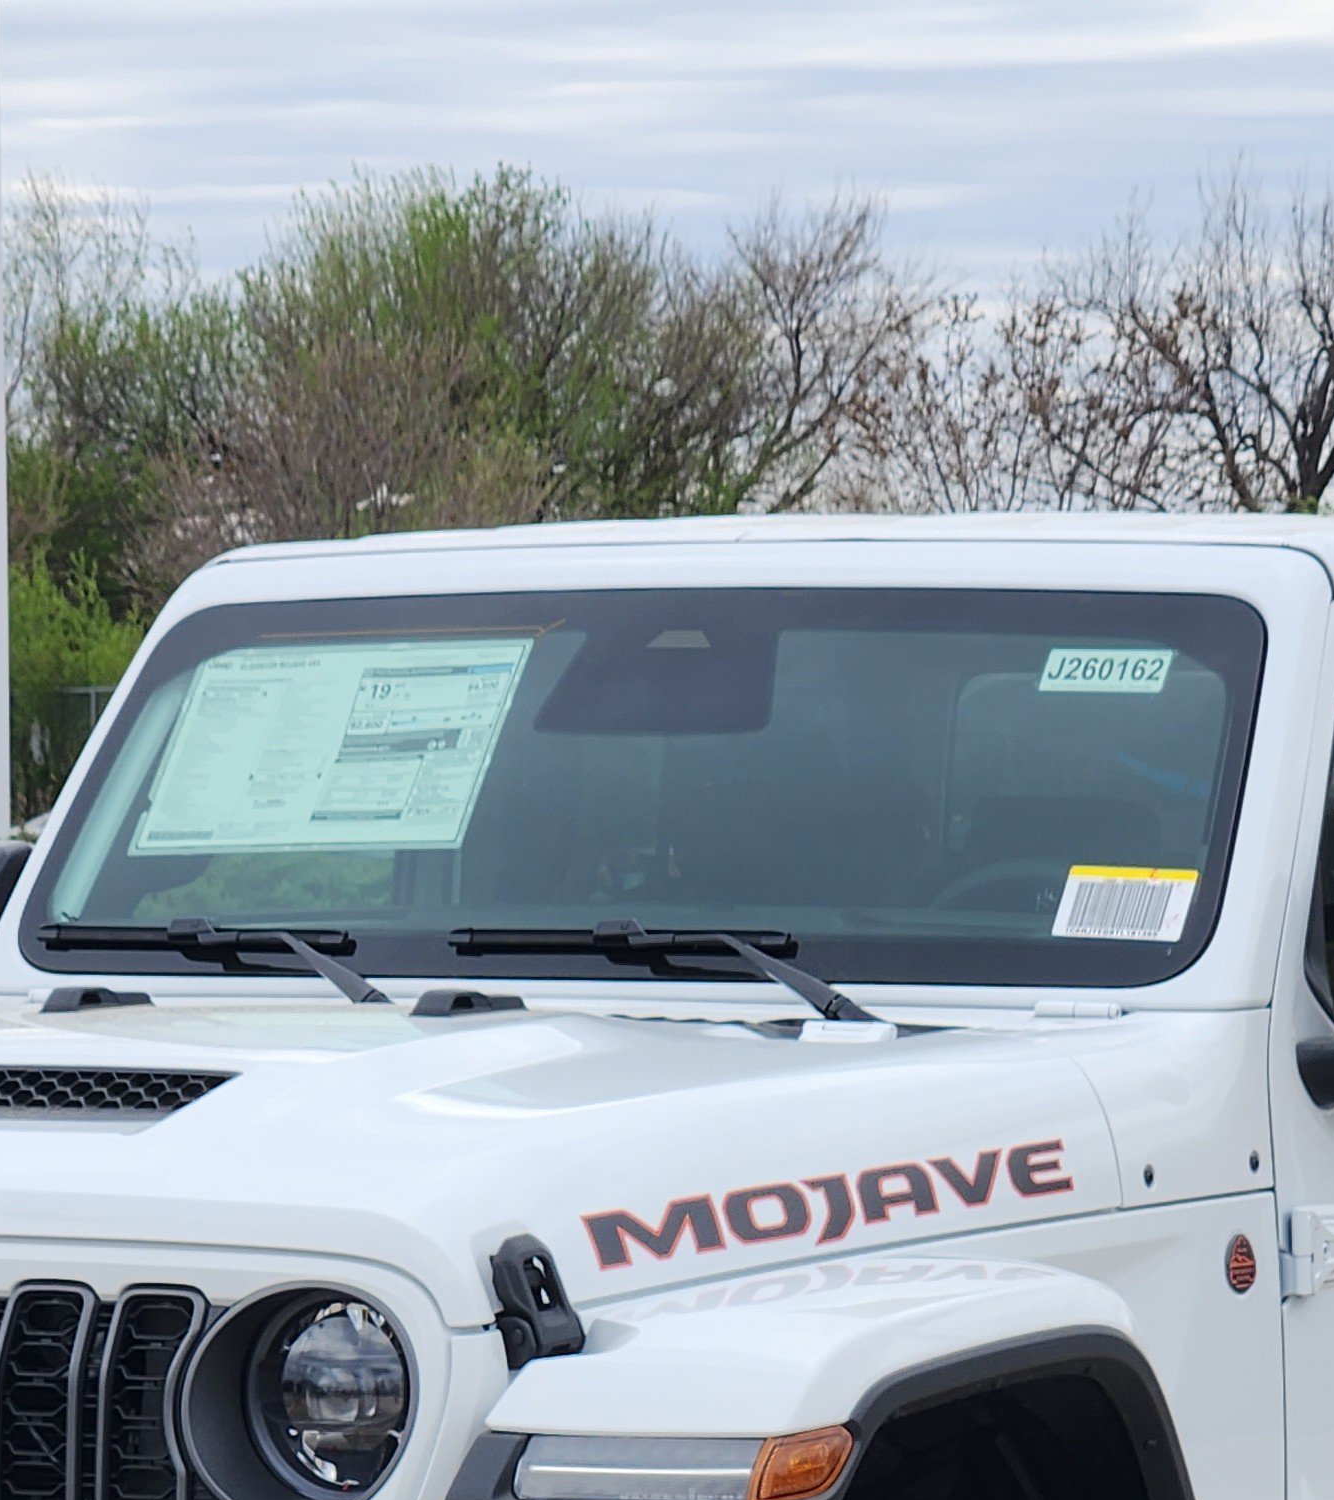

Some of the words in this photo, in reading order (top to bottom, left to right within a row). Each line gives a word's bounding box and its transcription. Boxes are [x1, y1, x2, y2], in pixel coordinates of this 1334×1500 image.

[1048, 657, 1165, 682] J260162
[370, 683, 392, 700] 19
[580, 1138, 1075, 1272] MOJAVE
